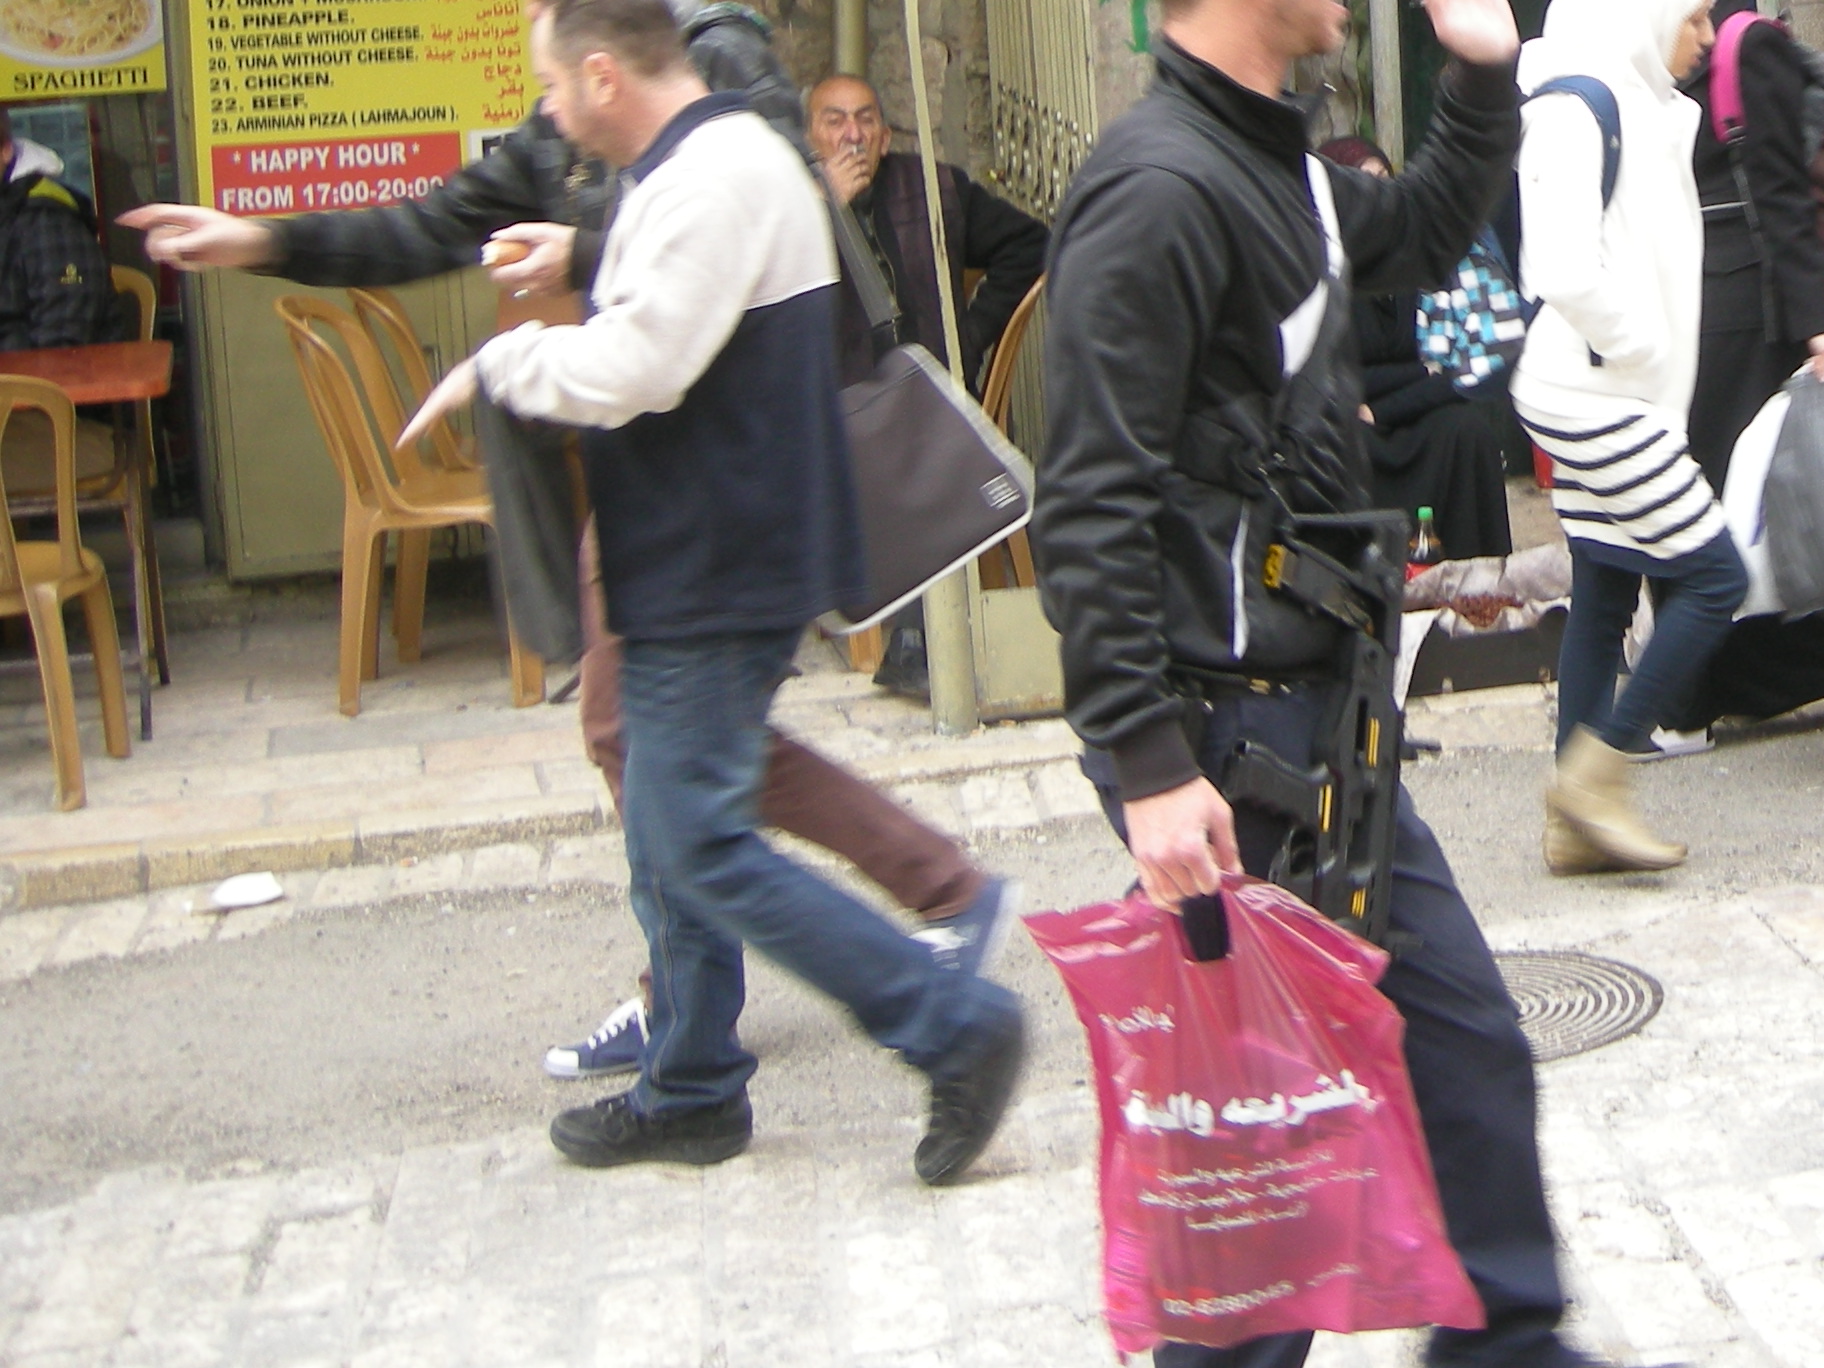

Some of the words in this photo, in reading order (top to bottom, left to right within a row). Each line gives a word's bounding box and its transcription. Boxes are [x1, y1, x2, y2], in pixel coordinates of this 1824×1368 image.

[207, 17, 235, 30] 18.
[243, 10, 355, 28] PINEAPPLE.
[208, 37, 226, 51] 19.
[231, 32, 302, 49] VEGETABLE
[307, 28, 366, 46] WITHOUT
[371, 26, 424, 42] CHEESE.
[209, 57, 230, 72] 20.
[236, 53, 277, 70] TUNA
[283, 51, 352, 67] WITHOUT
[358, 47, 419, 64] CHEESE.
[14, 65, 148, 93] SPAGHETTI
[210, 78, 237, 92] 21.
[245, 72, 334, 90] CHICKEN.
[211, 98, 243, 112] 22.
[252, 94, 308, 110] BEEF.
[212, 119, 232, 133] 23.
[237, 113, 305, 131] ARMINIAN
[310, 111, 348, 127] PIZZA
[360, 106, 447, 125] LAHMAJOUN
[250, 146, 330, 174] HAPPY
[338, 141, 406, 169] HOUR
[222, 184, 294, 212] FROM
